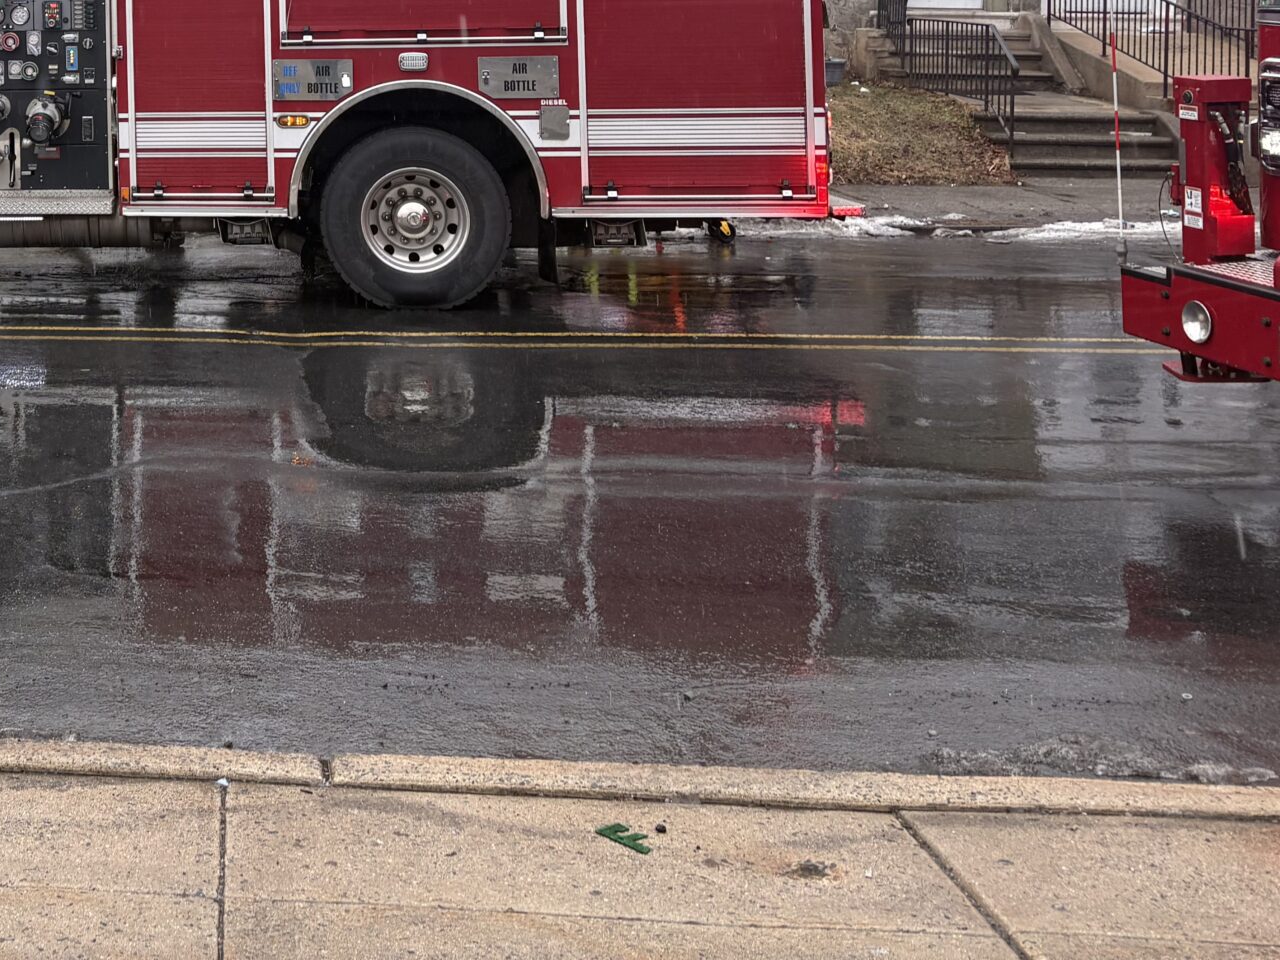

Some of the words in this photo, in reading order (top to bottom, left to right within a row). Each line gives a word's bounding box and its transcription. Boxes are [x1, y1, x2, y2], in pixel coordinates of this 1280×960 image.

[315, 65, 331, 77] AIR
[512, 62, 528, 75] AIR
[307, 82, 340, 94] BOTTLE
[504, 80, 537, 92] BOTTLE
[540, 98, 568, 106] DIESEL
